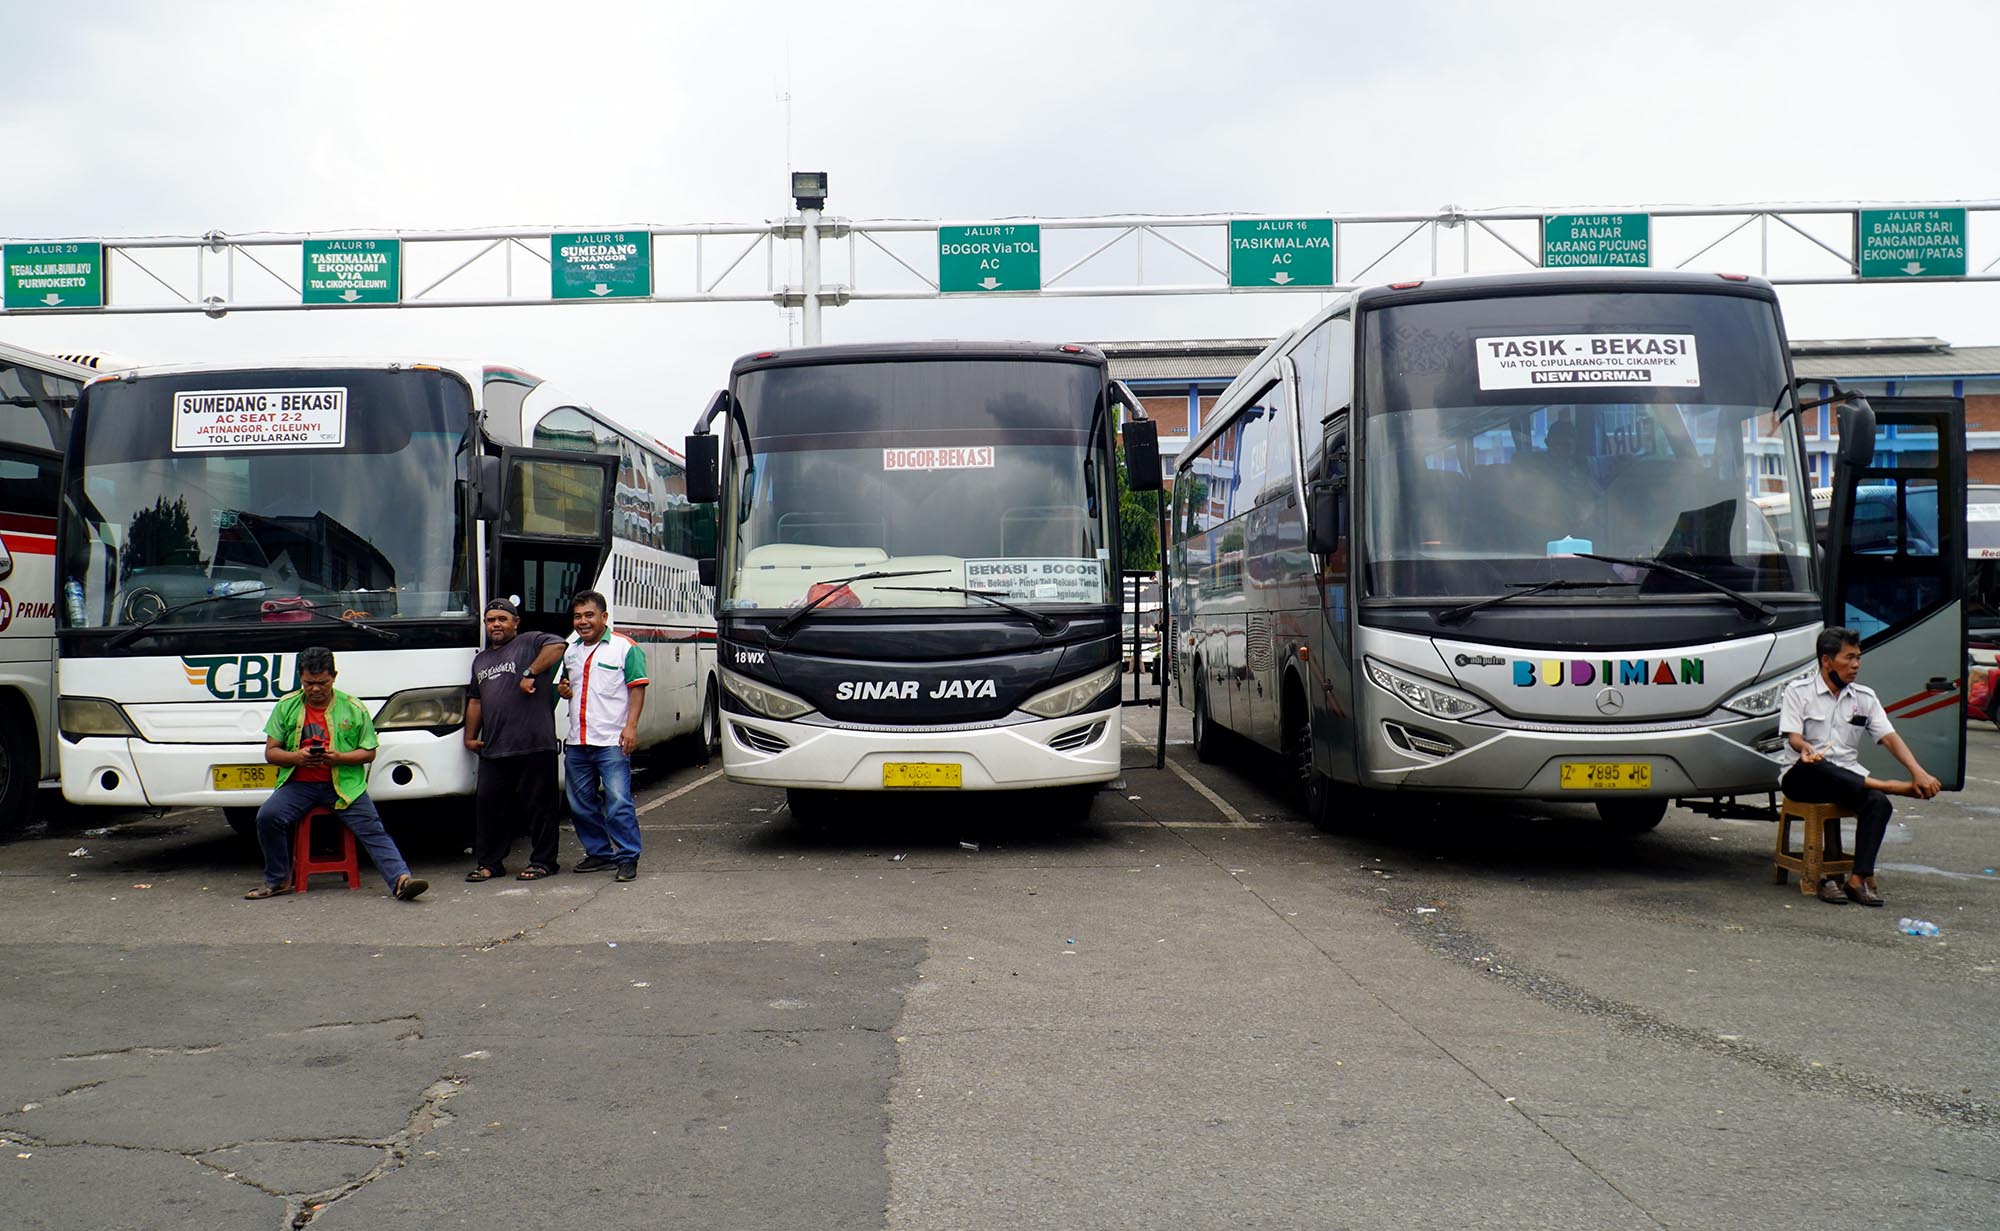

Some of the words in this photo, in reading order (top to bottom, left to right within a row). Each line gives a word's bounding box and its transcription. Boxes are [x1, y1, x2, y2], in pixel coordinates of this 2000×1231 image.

[1571, 217, 1609, 225] JALUR
[1612, 216, 1623, 225] 15
[1888, 211, 1925, 220] JALUR
[1928, 211, 1939, 219] 14
[1256, 222, 1293, 230] JALUR
[1296, 221, 1307, 230] 16
[1874, 222, 1922, 234] BANJAR
[1924, 221, 1953, 233] SARI
[964, 227, 1001, 236] JALUR
[1004, 227, 1015, 235] 17
[1571, 227, 1622, 239] BANJAR
[575, 234, 611, 243] JALUR
[614, 234, 624, 242] 18
[1233, 237, 1330, 249] TASIKMALAYA
[1867, 235, 1959, 247] PANGANDARAN
[27, 245, 62, 254] JALUR
[66, 245, 78, 253] 20
[327, 241, 362, 249] JALUR
[365, 241, 375, 249] 19
[560, 244, 637, 256] SUMEDANG
[941, 243, 990, 255] BOGOR
[992, 243, 1012, 253] Via
[1013, 242, 1038, 253] TOL
[1547, 241, 1596, 252] KARANG
[1599, 239, 1647, 251] PUCUNG
[311, 253, 387, 264] TASIKMALAYA
[980, 258, 1000, 269] AC
[1272, 253, 1292, 264] AC
[317, 263, 379, 272] EKONOMI
[336, 272, 363, 280] VIA
[18, 277, 86, 288] PURWOKERTO
[311, 280, 325, 288] TOL
[1488, 339, 1568, 358] TASIK
[1591, 338, 1687, 356] BEKASI
[1500, 360, 1517, 369] VIA
[1520, 359, 1538, 368] TOL
[1627, 357, 1677, 366] CIKAMPEK
[1534, 371, 1573, 382] NEW
[1578, 370, 1649, 381] NORMAL
[183, 396, 267, 414] SUMEDANG
[281, 394, 338, 411] BEKASI
[216, 415, 235, 423] AC
[240, 413, 276, 423] SEAT
[281, 412, 302, 422] 2-2
[196, 424, 262, 435] JATINANGOR
[272, 423, 321, 432] CILEUNYI
[208, 435, 229, 444] TOL
[233, 433, 308, 443] CIPULARANG
[969, 564, 1028, 575] BEKASI
[1042, 564, 1098, 575] BOGOR
[1512, 657, 1705, 687] BUDIMAN
[836, 680, 920, 701] SINAR
[929, 679, 997, 699] JAYA
[237, 767, 265, 781] 7586
[1564, 765, 1572, 780] Z
[1588, 765, 1620, 780] 7895
